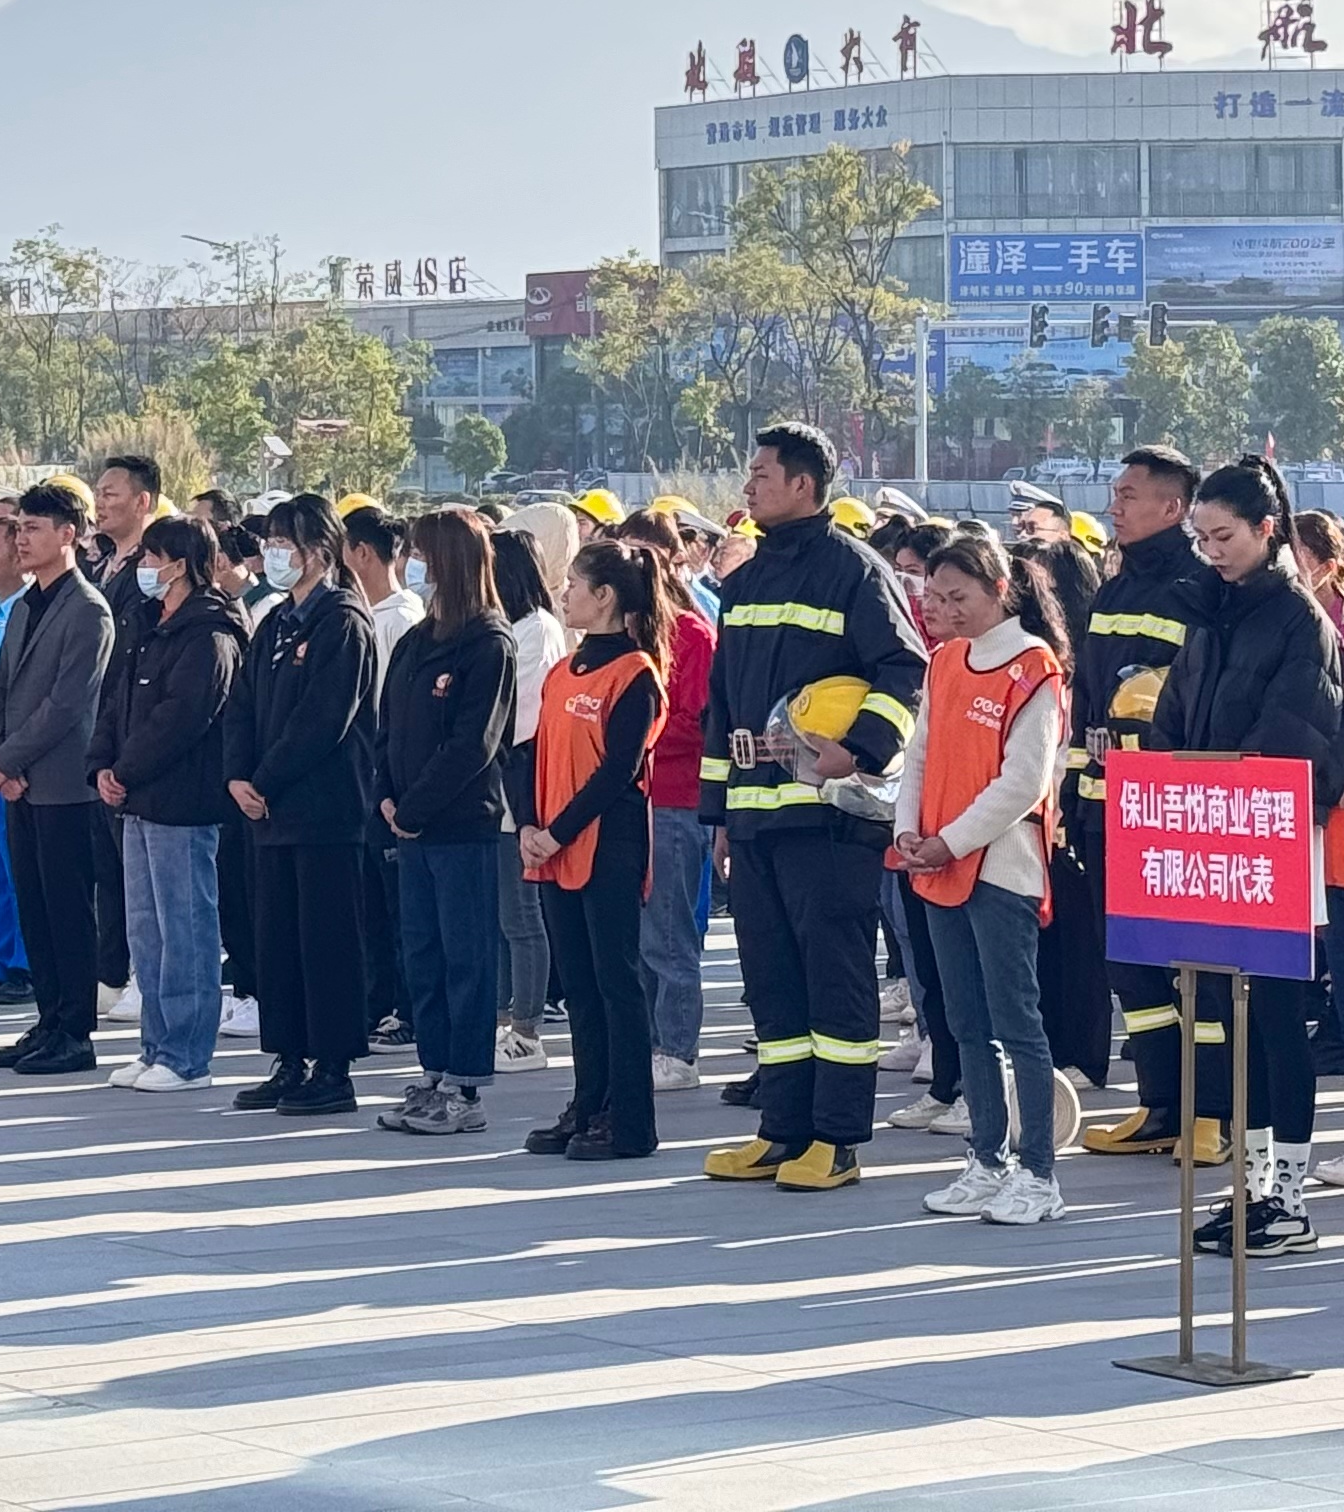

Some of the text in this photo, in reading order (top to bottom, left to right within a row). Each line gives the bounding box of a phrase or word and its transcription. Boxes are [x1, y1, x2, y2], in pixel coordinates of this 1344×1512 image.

[1119, 779, 1296, 840] 保山吾悦商业管理
[1140, 846, 1275, 905] 有限公司代表
